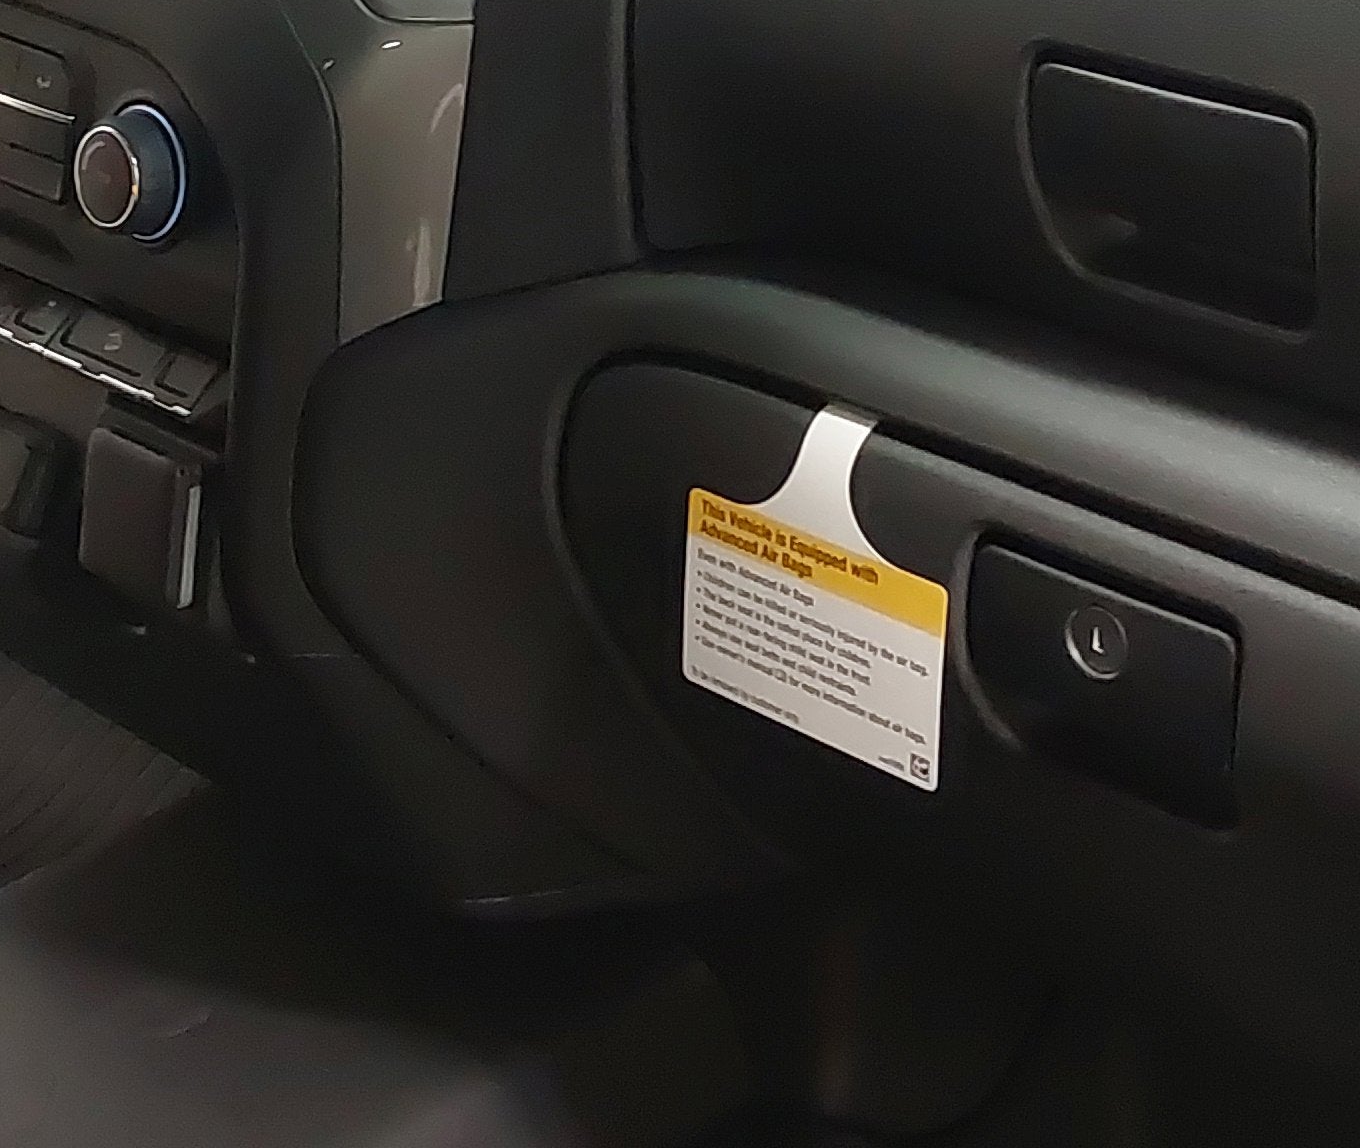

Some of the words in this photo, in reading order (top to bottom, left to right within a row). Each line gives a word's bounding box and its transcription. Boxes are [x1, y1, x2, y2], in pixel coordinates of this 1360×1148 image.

[700, 519, 758, 555] Advanced
[761, 544, 778, 563] Air
[781, 552, 813, 578] Bags
[702, 499, 725, 522] This
[729, 511, 772, 542] Vehicle
[775, 529, 787, 547] is
[790, 535, 847, 572] Equipped
[851, 563, 878, 585] with
[719, 559, 737, 573] with
[739, 566, 777, 591] Advanced
[780, 583, 791, 596] Air
[837, 630, 866, 649] injured
[880, 648, 895, 661] the
